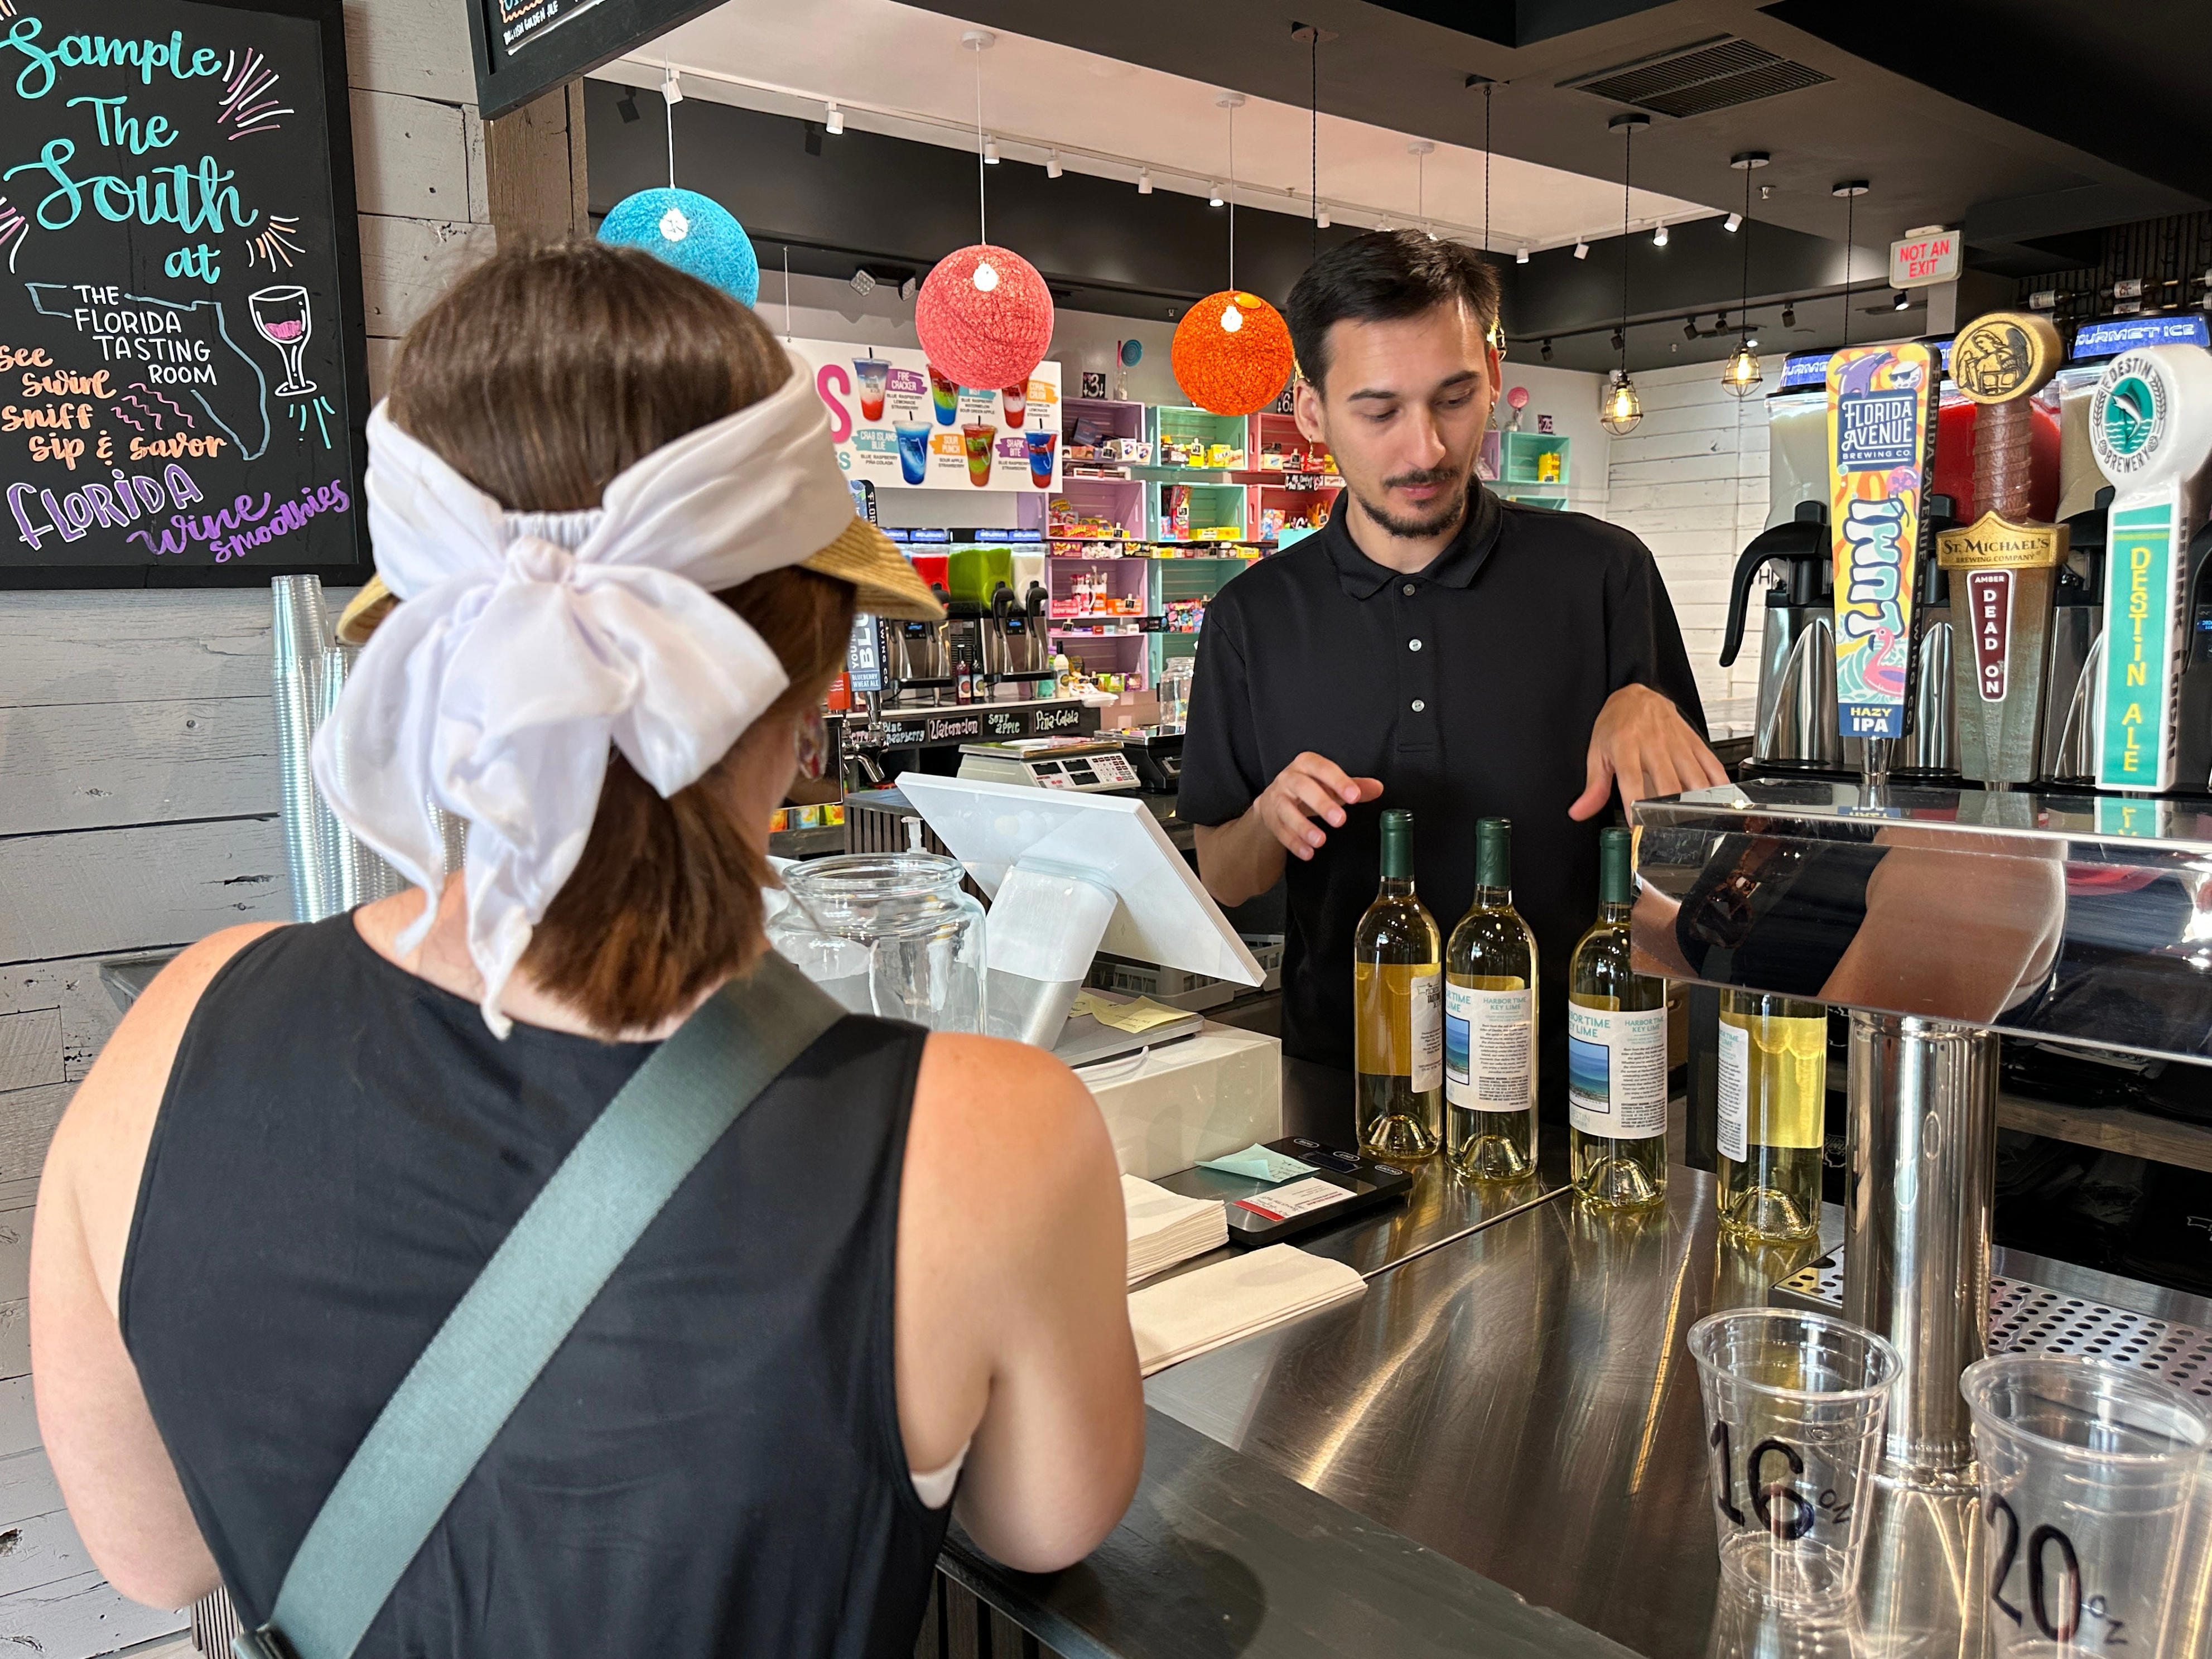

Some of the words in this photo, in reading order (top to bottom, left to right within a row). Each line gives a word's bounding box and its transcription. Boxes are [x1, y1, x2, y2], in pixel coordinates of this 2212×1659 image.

[0, 17, 222, 99] Sample
[66, 96, 179, 155] The
[3, 138, 259, 233] South
[1900, 243, 1927, 262] NOT
[1930, 239, 1949, 257] AN
[165, 244, 221, 284] at
[1909, 259, 1938, 278] EXIT
[73, 285, 119, 306] THE
[75, 309, 182, 334] FLORIDA
[2163, 324, 2194, 337] ICE
[93, 335, 211, 362] TASTING
[147, 365, 217, 385] ROOM
[897, 372, 909, 381] FIRE
[2109, 358, 2152, 383] DESTIN
[891, 380, 916, 391] CRACKER
[1842, 401, 1912, 429] FLORIDA
[1925, 364, 1941, 460] FLORIDA
[860, 431, 876, 440] CRAB
[876, 432, 897, 442] ISLAND
[871, 441, 886, 450] BLUE
[943, 435, 958, 444] SOUR
[1006, 439, 1024, 448] SHARK
[1842, 418, 1912, 451] AVENUE
[96, 430, 113, 465] &
[942, 444, 960, 454] PUNCH
[1009, 448, 1021, 457] BITE
[1843, 450, 1892, 460] BREWING
[2104, 447, 2151, 473] BREWERY
[1918, 467, 1935, 560] AVENUE
[1965, 538, 2050, 556] MICHAEL'S
[1994, 553, 2035, 562] COMPANY
[1843, 498, 1905, 638] LUMI
[1907, 575, 1923, 686] BREWING
[1983, 590, 1998, 650] DEAD
[1984, 665, 1999, 693] ON
[1851, 708, 1892, 717] HAZY
[930, 718, 978, 740] Watermelon
[1853, 717, 1888, 732] IPA
[2122, 703, 2143, 772] ALE
[1452, 992, 1471, 1004] TIME
[1577, 1025, 1598, 1038] LIME
[1584, 1016, 1611, 1029] TIME
[1710, 1419, 1815, 1540] 16
[1986, 1492, 2082, 1642] 20
